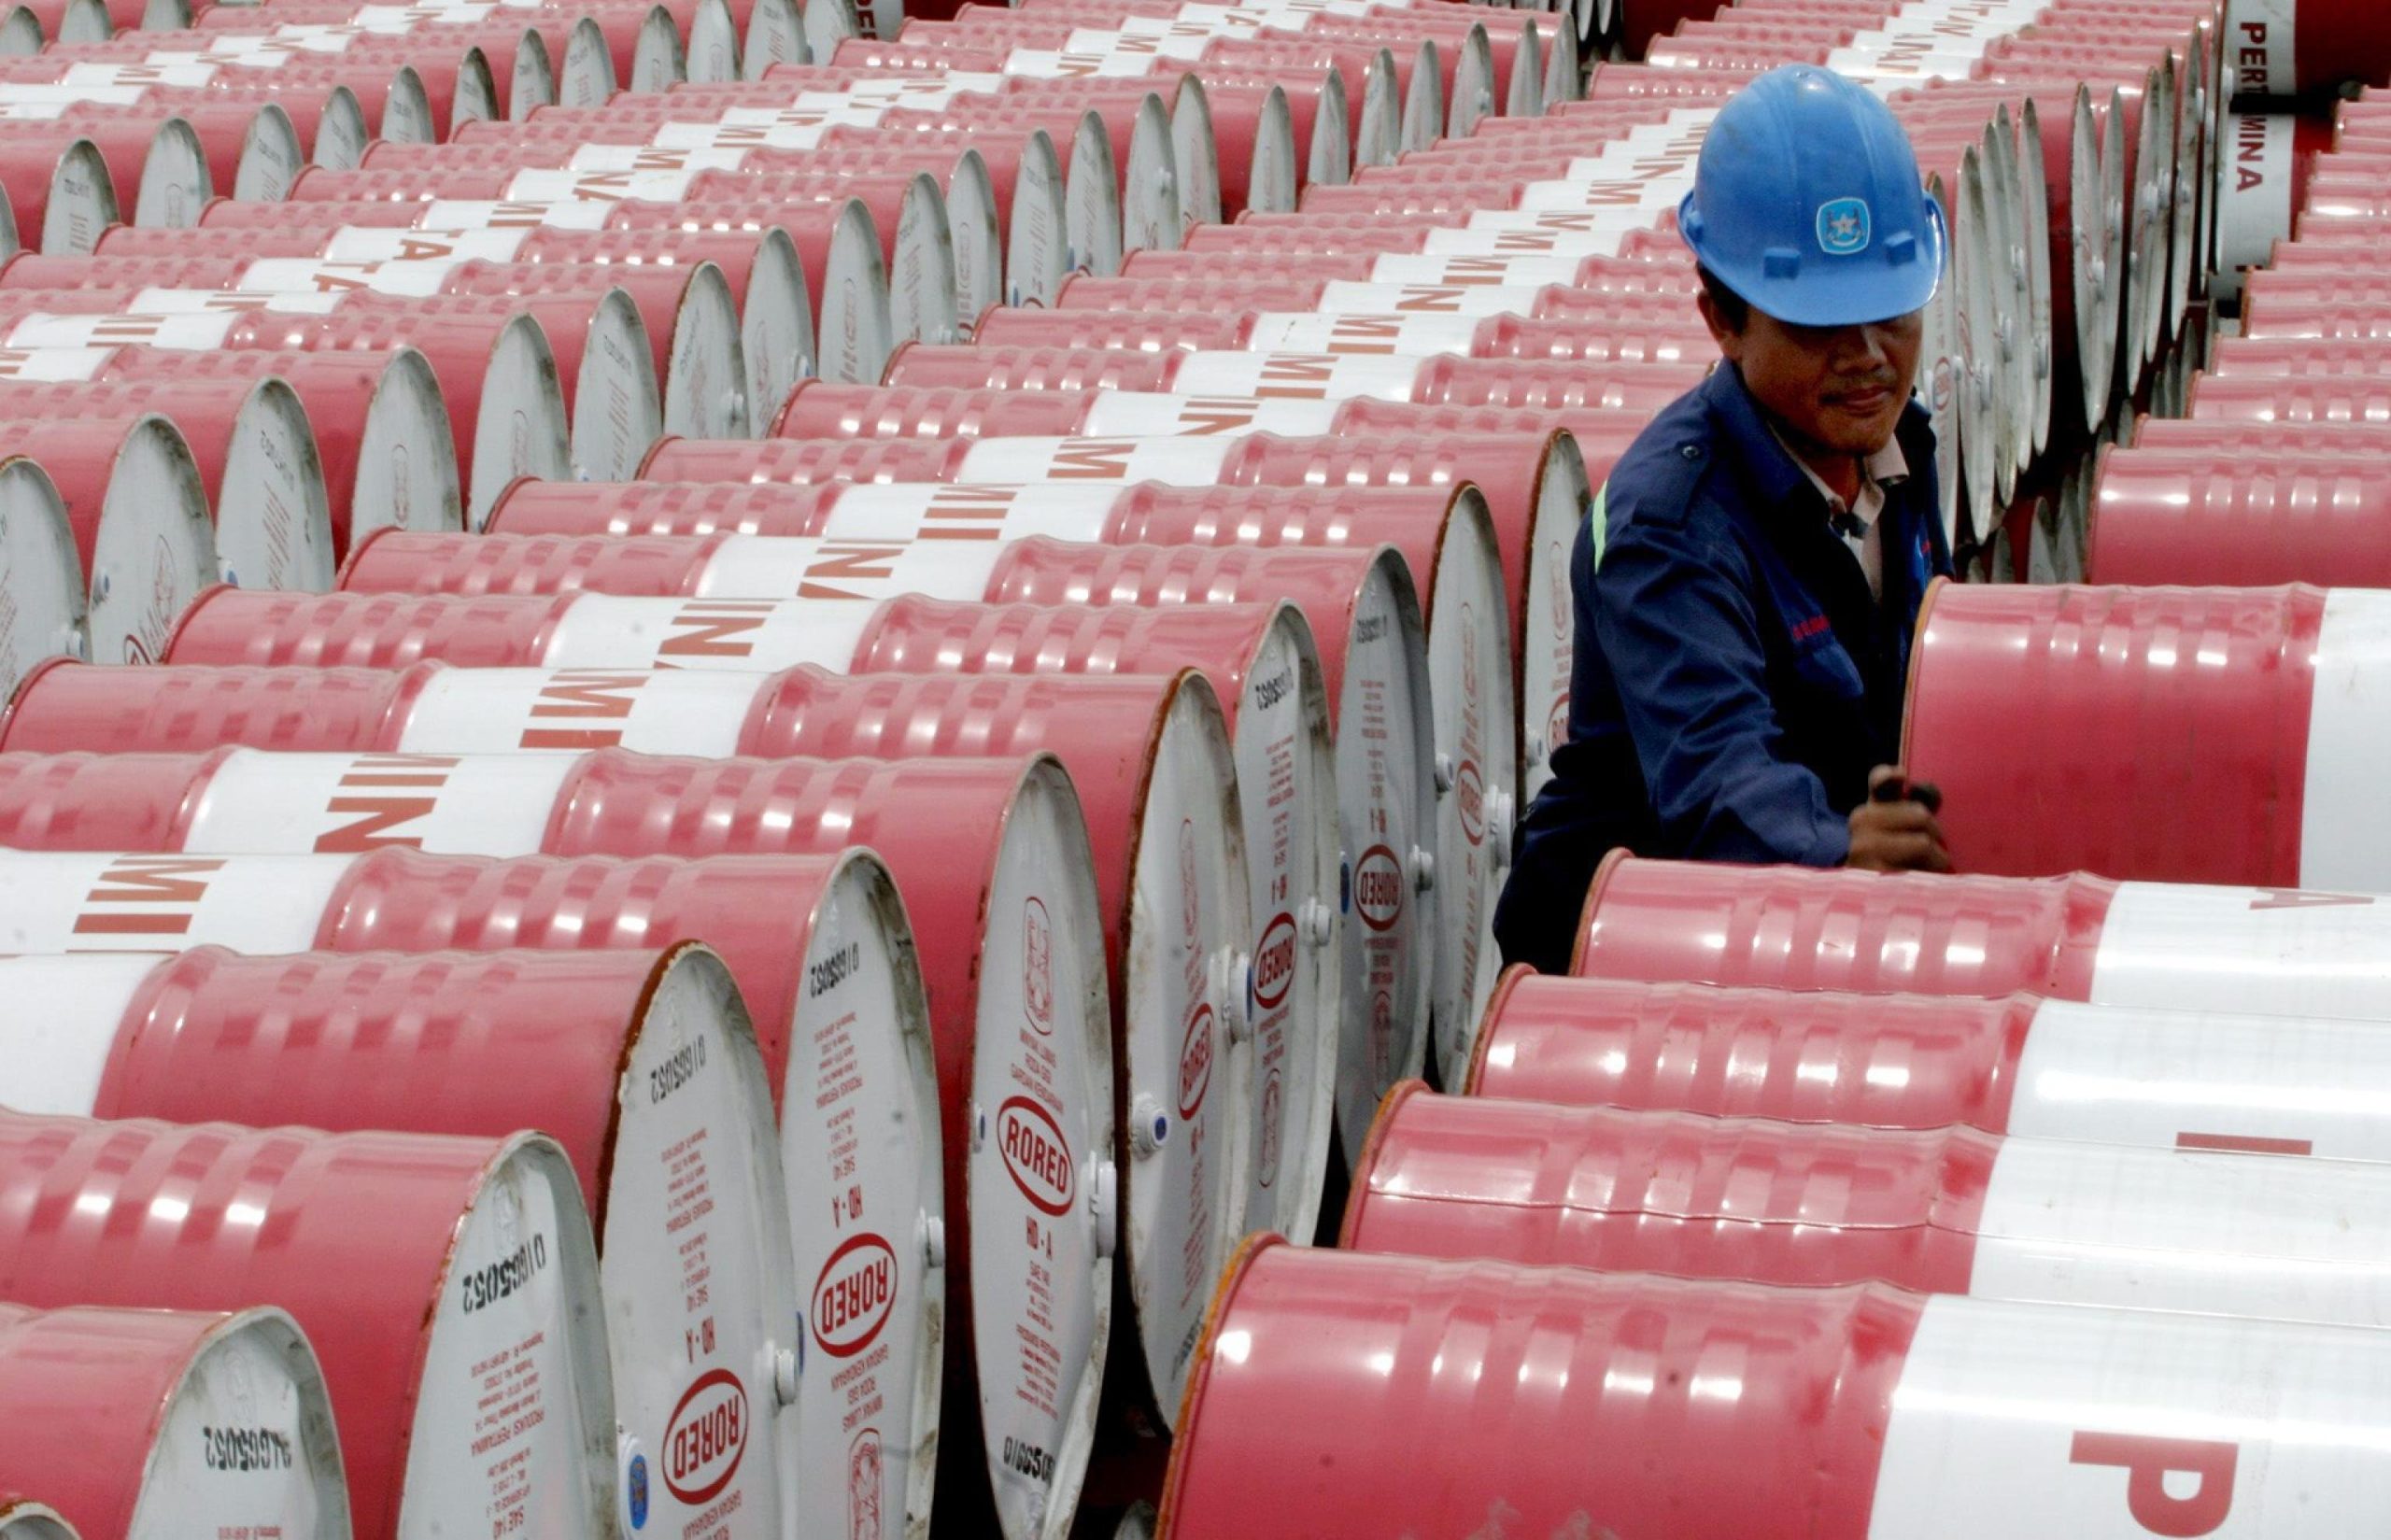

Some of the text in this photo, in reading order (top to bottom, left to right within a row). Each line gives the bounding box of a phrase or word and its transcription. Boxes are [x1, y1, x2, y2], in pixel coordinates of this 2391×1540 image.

[2236, 22, 2270, 192] PERMINA
[1360, 872, 1399, 906] RORED
[1259, 935, 1295, 989] RORED
[1006, 1114, 1068, 1194] RORED
[822, 1255, 888, 1335] RORED
[674, 1393, 740, 1480] RORED
